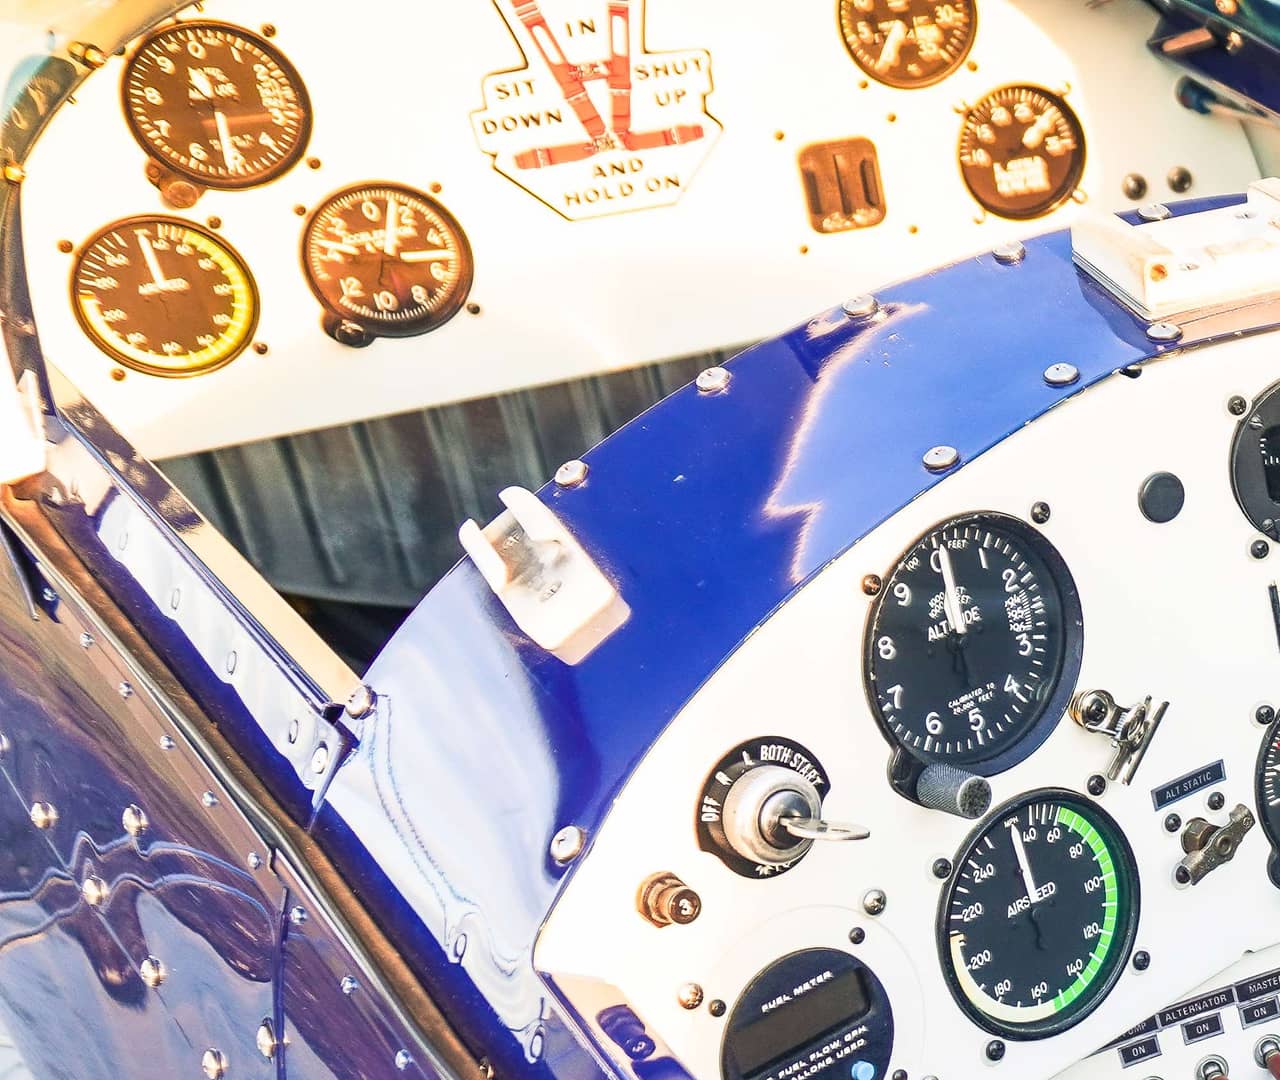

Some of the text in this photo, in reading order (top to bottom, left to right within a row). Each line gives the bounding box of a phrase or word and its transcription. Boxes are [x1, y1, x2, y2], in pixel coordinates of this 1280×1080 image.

[565, 19, 596, 37] IN
[635, 58, 702, 80] SHUT
[495, 80, 535, 99] SIT
[655, 90, 687, 107] UP
[482, 110, 562, 134] DOWN
[593, 158, 644, 178] AND
[565, 175, 680, 206] HOLD ON
[374, 291, 399, 311] 10
[947, 539, 967, 549] FEET
[978, 548, 988, 569] 1
[1002, 568, 1020, 592] 2
[893, 582, 912, 606] 9
[878, 635, 897, 660] 8
[1015, 632, 1032, 657] 3
[1004, 674, 1021, 693] 4
[887, 684, 904, 710] 7
[925, 711, 943, 735] 6
[968, 707, 985, 731] 5
[742, 750, 755, 766] L
[760, 744, 790, 764] BOTH
[790, 752, 824, 786] START
[1165, 771, 1213, 800] ALT STATIC
[701, 796, 721, 822] OFF
[1023, 826, 1037, 842] 40
[1046, 827, 1061, 843] 60
[1069, 843, 1083, 859] 80
[972, 863, 994, 883] 240
[1084, 876, 1100, 894] 100
[1007, 882, 1056, 918] AIRSEED
[962, 903, 982, 922] 220
[1083, 922, 1099, 939] 120
[970, 950, 991, 970] 200
[1066, 959, 1083, 977] 140
[761, 970, 834, 1013] FUEL METER
[994, 979, 1011, 997] 180
[1030, 981, 1047, 999] 160
[1165, 993, 1228, 1022] ALTERNATOR
[1254, 1006, 1267, 1018] ON
[1196, 1023, 1210, 1034] ON
[836, 1038, 866, 1059] USED
[1132, 1045, 1146, 1057] ON
[778, 1060, 808, 1080] FUEL
[809, 1039, 842, 1062] FLOW
